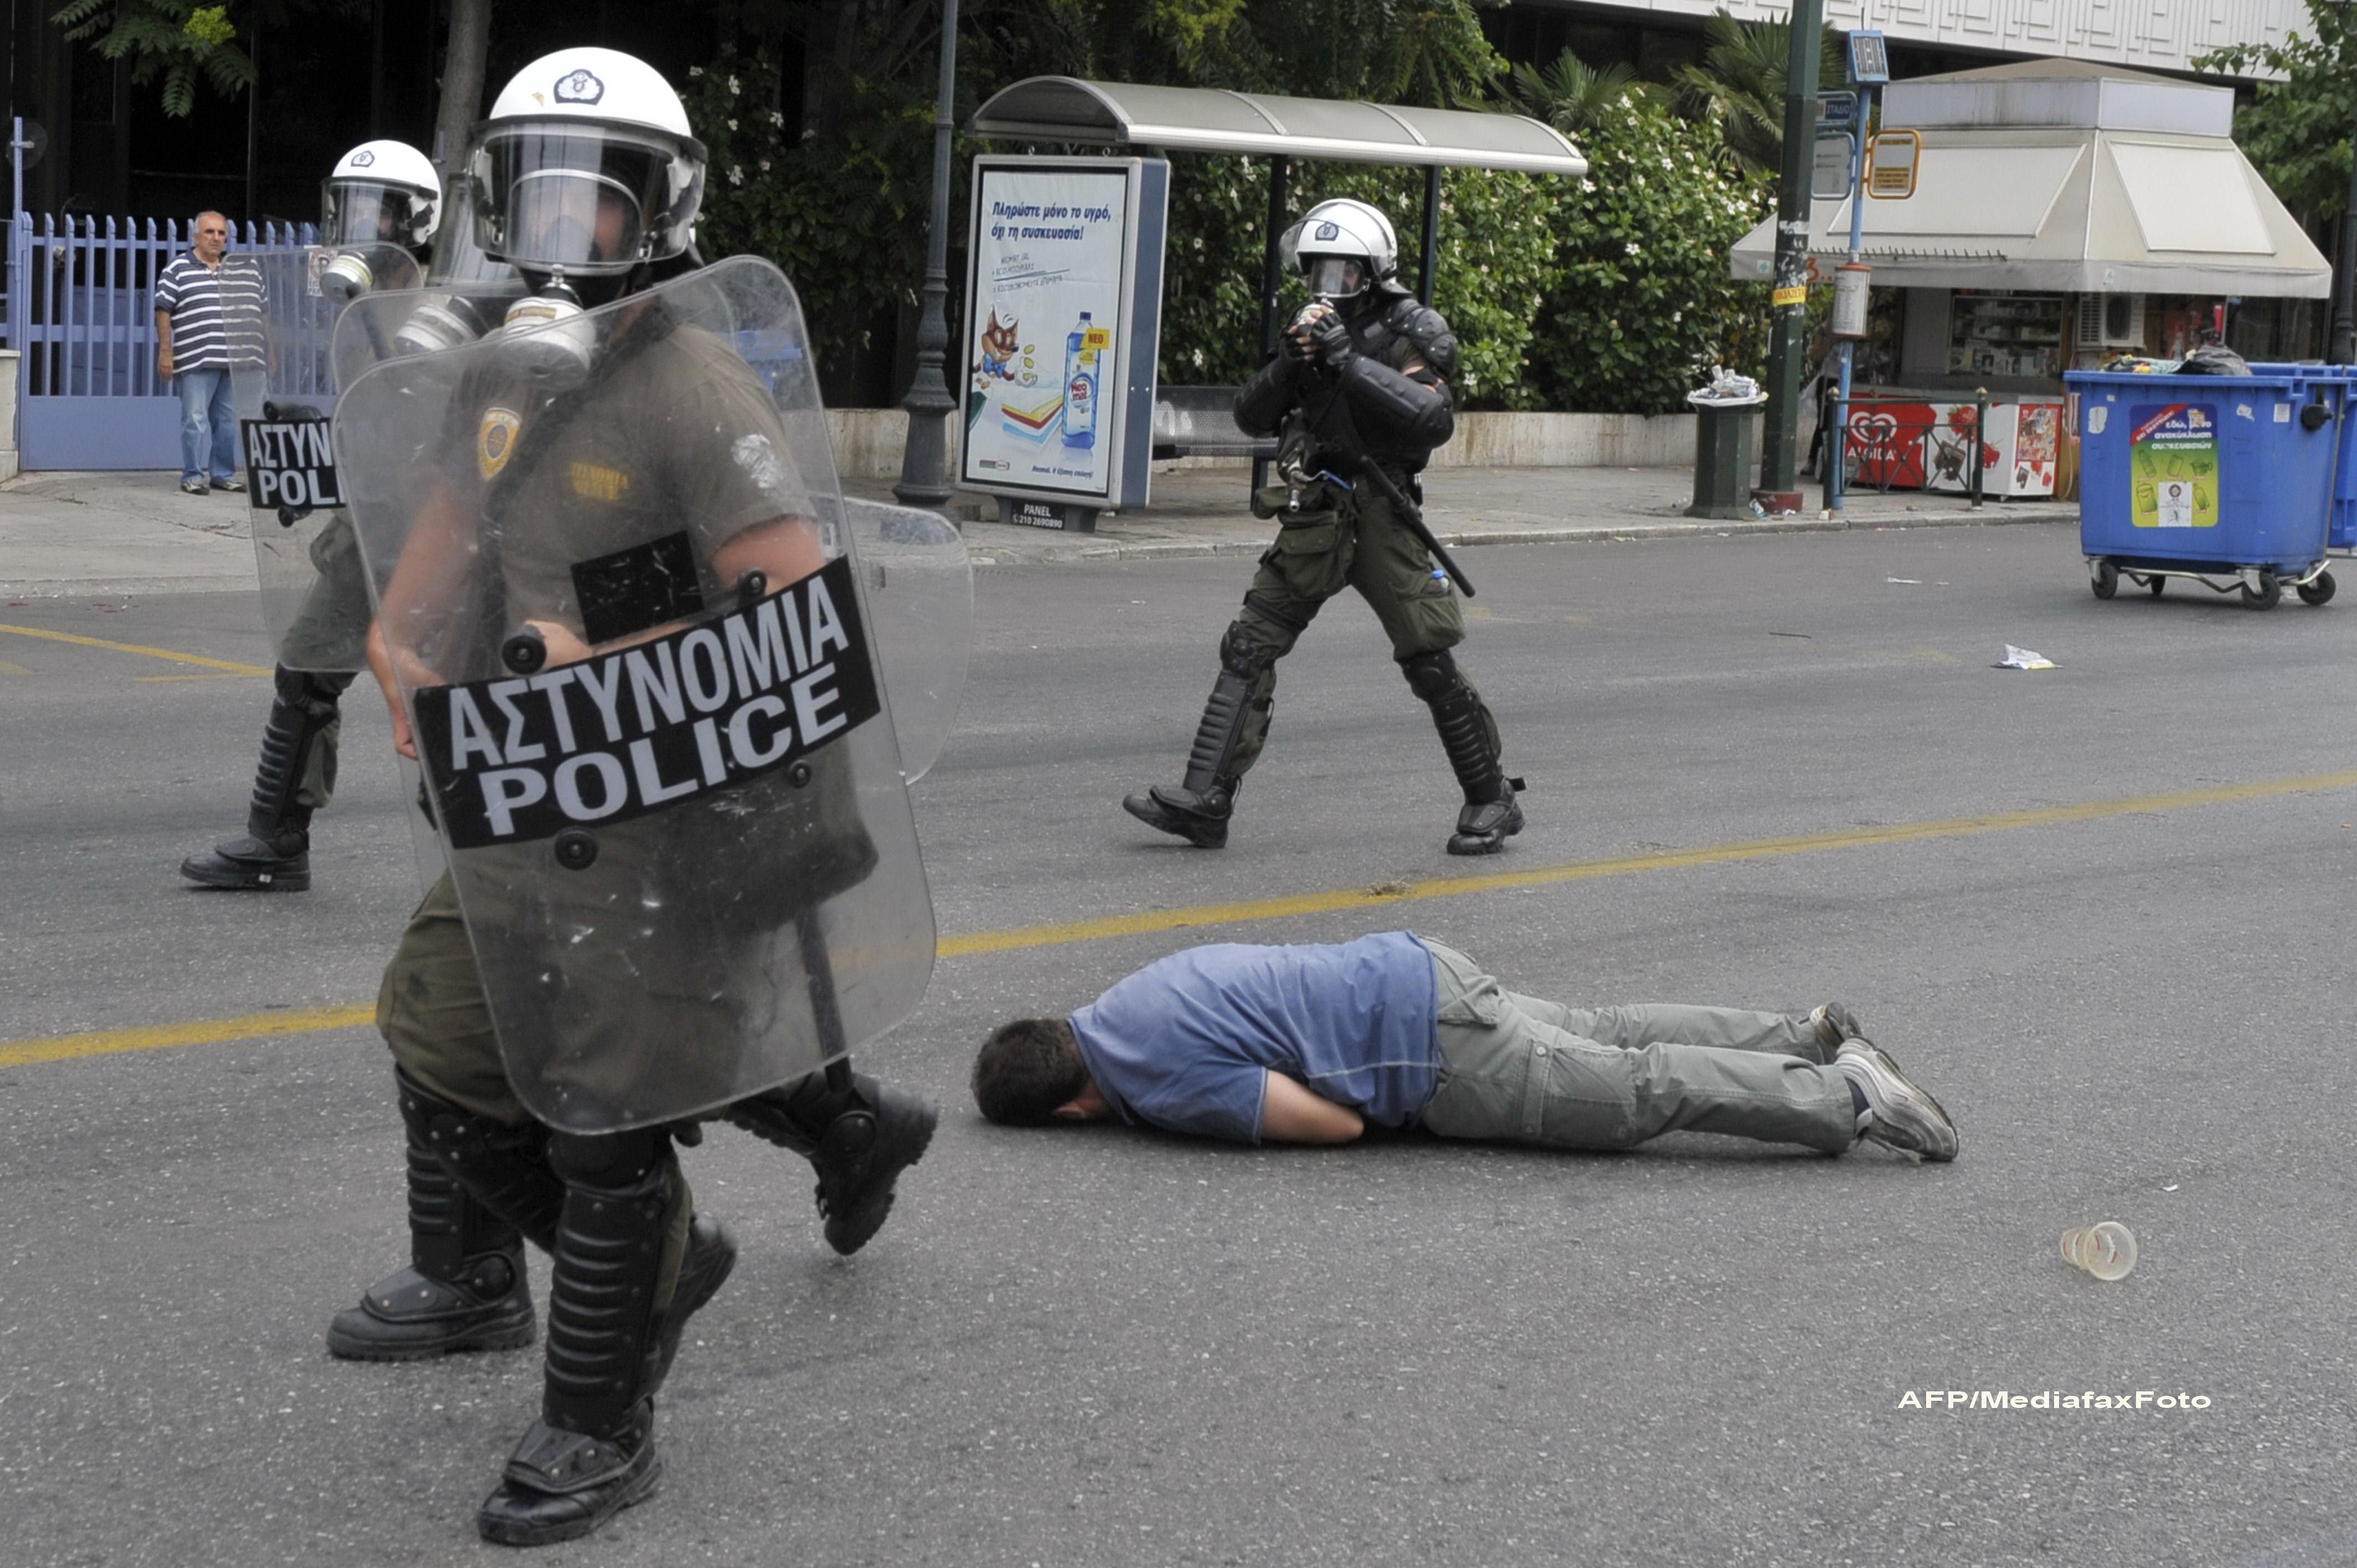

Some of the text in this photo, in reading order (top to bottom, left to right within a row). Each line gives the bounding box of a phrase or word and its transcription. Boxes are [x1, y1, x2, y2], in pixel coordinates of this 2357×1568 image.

[992, 202, 1111, 223] Πληρώστε μόνο το υγρό,
[991, 222, 1084, 241] όχι τη συσκευασία!
[1088, 333, 1104, 344] ΝΕΟ
[1019, 515, 1032, 524] 210
[1024, 504, 1051, 517] PANEL
[448, 575, 850, 771] ΑΣΤΥΝΟΜΙΑ
[478, 662, 847, 837] POLICE
